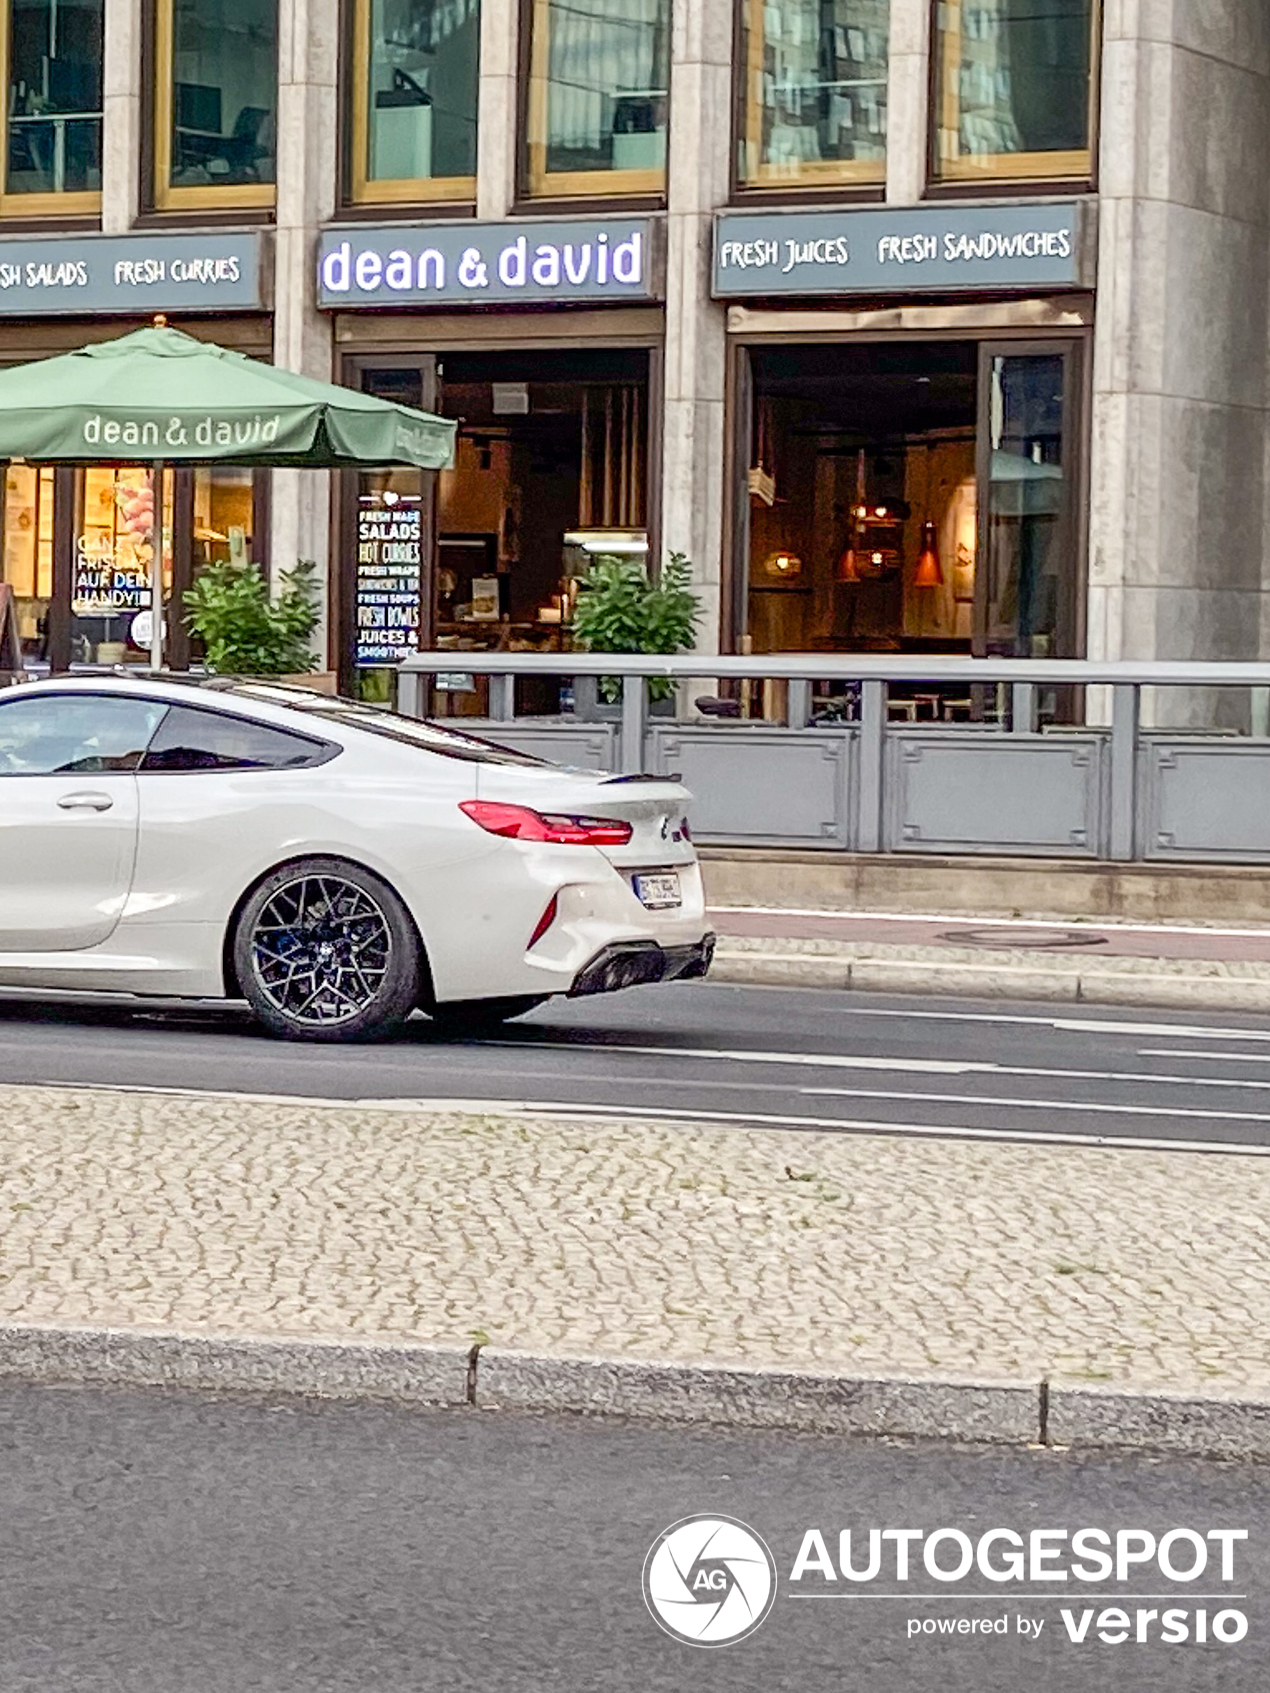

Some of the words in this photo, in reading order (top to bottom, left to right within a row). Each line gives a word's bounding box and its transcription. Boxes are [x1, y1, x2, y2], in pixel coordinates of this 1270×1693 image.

[717, 239, 779, 269] FRESH
[781, 237, 848, 273] JUICES
[877, 236, 937, 264] FRESH
[943, 229, 1071, 262] SANDWICHES
[26, 261, 88, 288] SALADS
[114, 259, 166, 286] FRESH
[170, 256, 240, 284] CURRIES
[322, 242, 446, 291] dean
[458, 248, 489, 288] &
[498, 232, 642, 288] david
[83, 414, 159, 446] dean
[165, 416, 189, 446] &
[195, 414, 280, 446] david
[358, 523, 421, 541] SALADS
[358, 542, 379, 565] HOT
[77, 572, 110, 588] AUF
[357, 606, 386, 627] FRESH
[357, 629, 406, 645] JUICES
[407, 630, 420, 645] &
